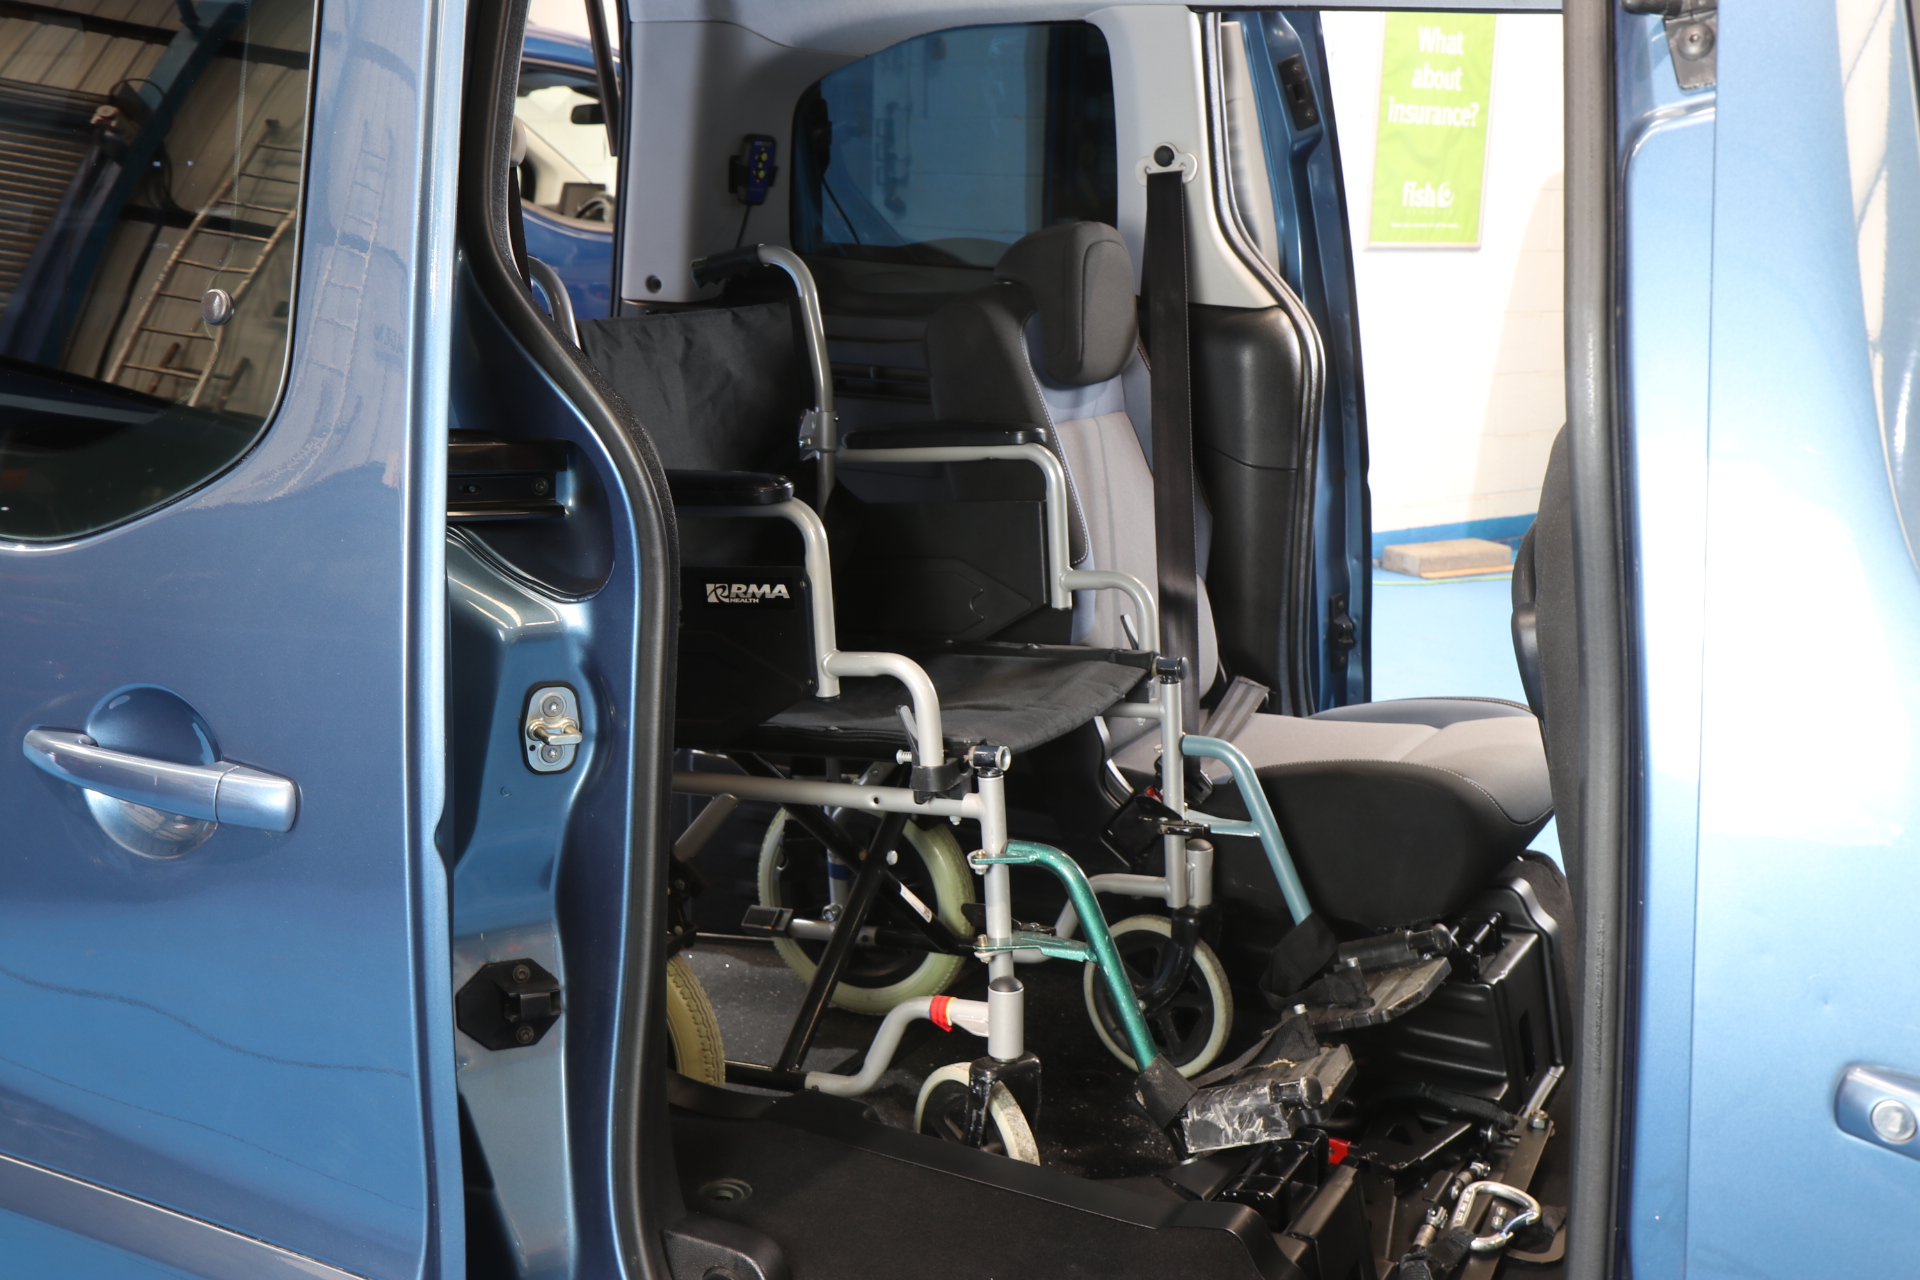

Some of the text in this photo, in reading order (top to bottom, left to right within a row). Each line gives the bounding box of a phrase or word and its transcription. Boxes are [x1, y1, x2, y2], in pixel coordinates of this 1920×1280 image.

[1418, 25, 1465, 55] What
[1411, 61, 1463, 91] about
[1387, 95, 1480, 127] insurance?
[1401, 180, 1437, 208] fish
